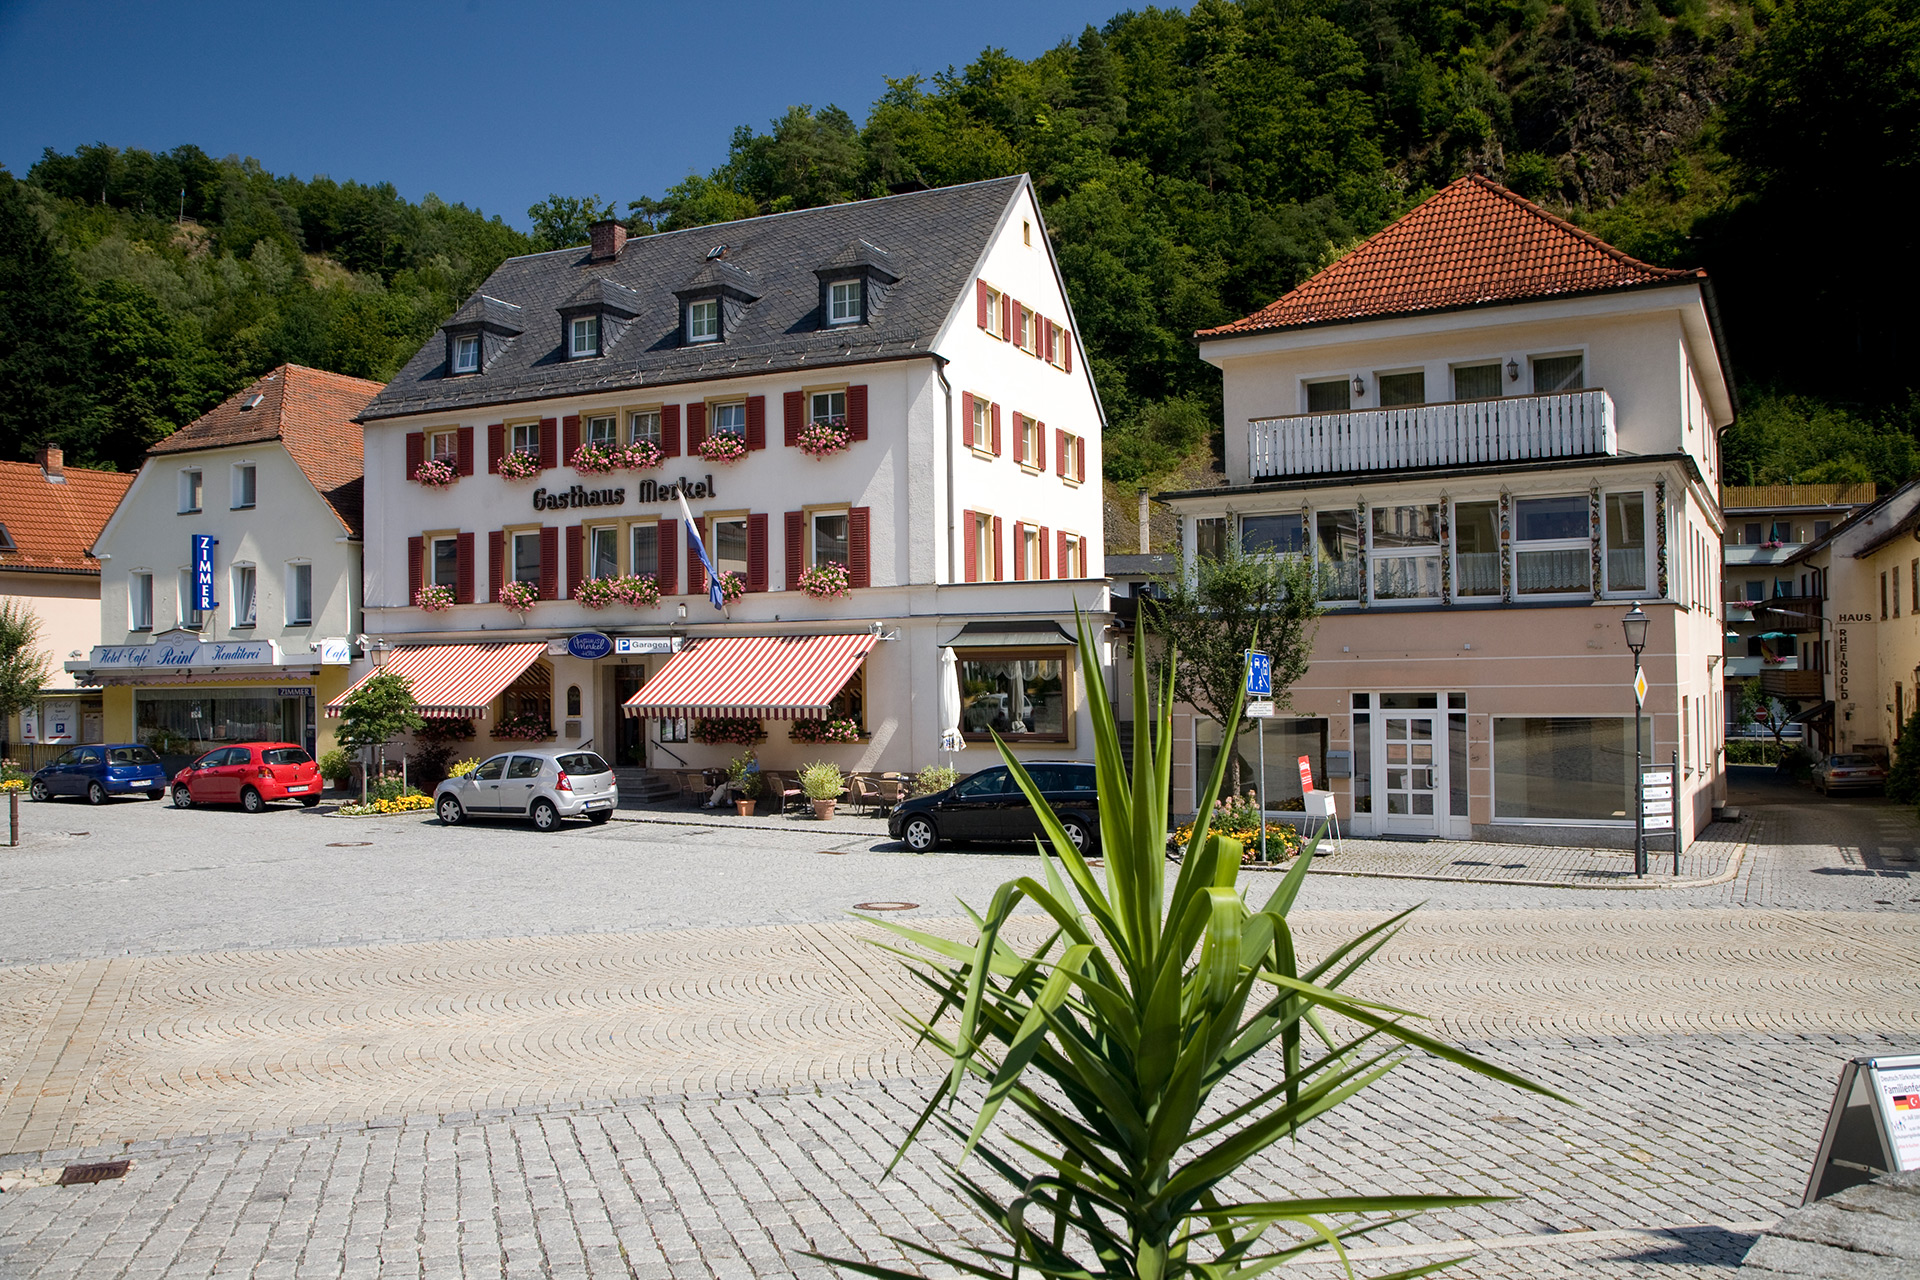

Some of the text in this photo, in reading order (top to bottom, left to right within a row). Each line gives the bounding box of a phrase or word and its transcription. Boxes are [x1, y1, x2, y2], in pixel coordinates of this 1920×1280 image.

[533, 474, 716, 511] Gasthaus Merkel
[199, 536, 211, 608] ZIMMER
[1839, 613, 1872, 621] HAUS
[212, 645, 261, 660] Konditorei
[325, 645, 349, 662] Café
[632, 641, 668, 649] Garagen
[100, 648, 122, 664] Hotel
[157, 645, 200, 665] Reinl
[1839, 629, 1848, 700] RHEINGOLD
